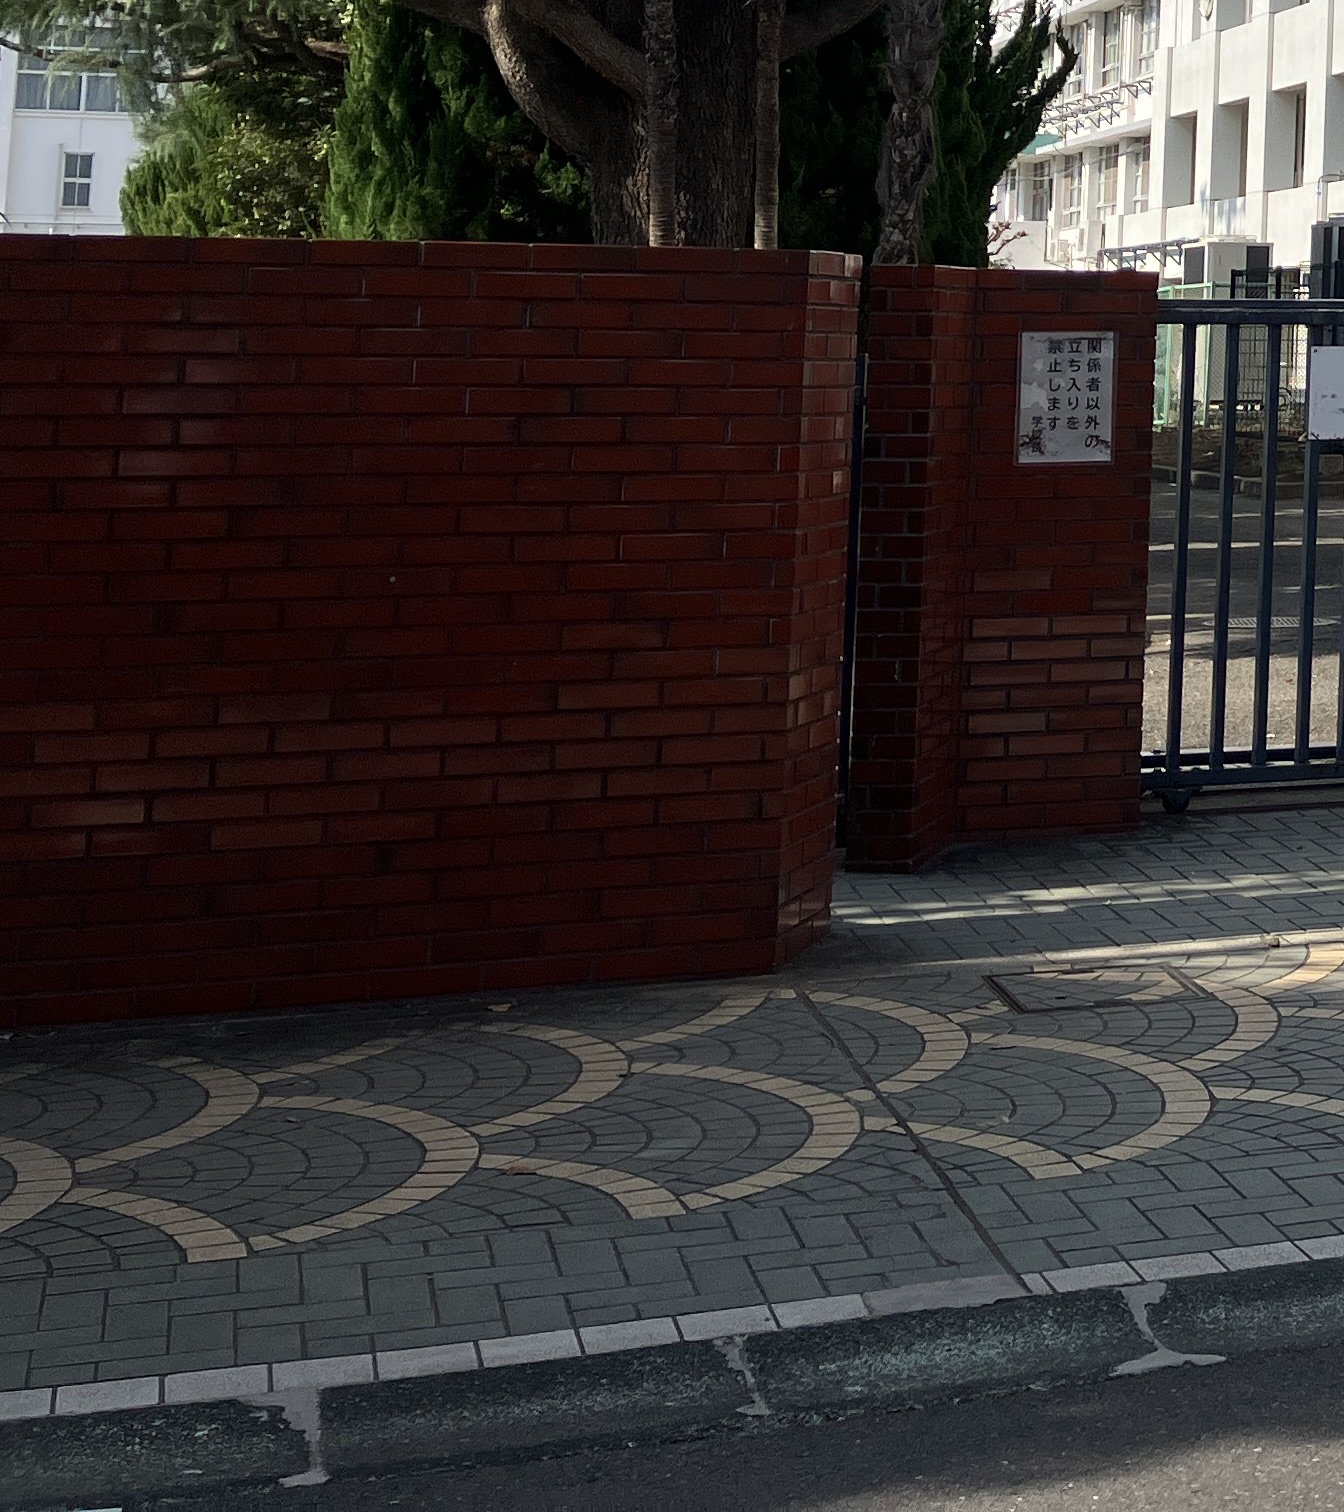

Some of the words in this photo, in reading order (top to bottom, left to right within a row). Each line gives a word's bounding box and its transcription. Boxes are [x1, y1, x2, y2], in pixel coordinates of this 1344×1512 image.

[1047, 340, 1063, 430] 禁止します
[1067, 340, 1082, 430] 立ち入りを
[1086, 339, 1102, 448] 関係者以外の
